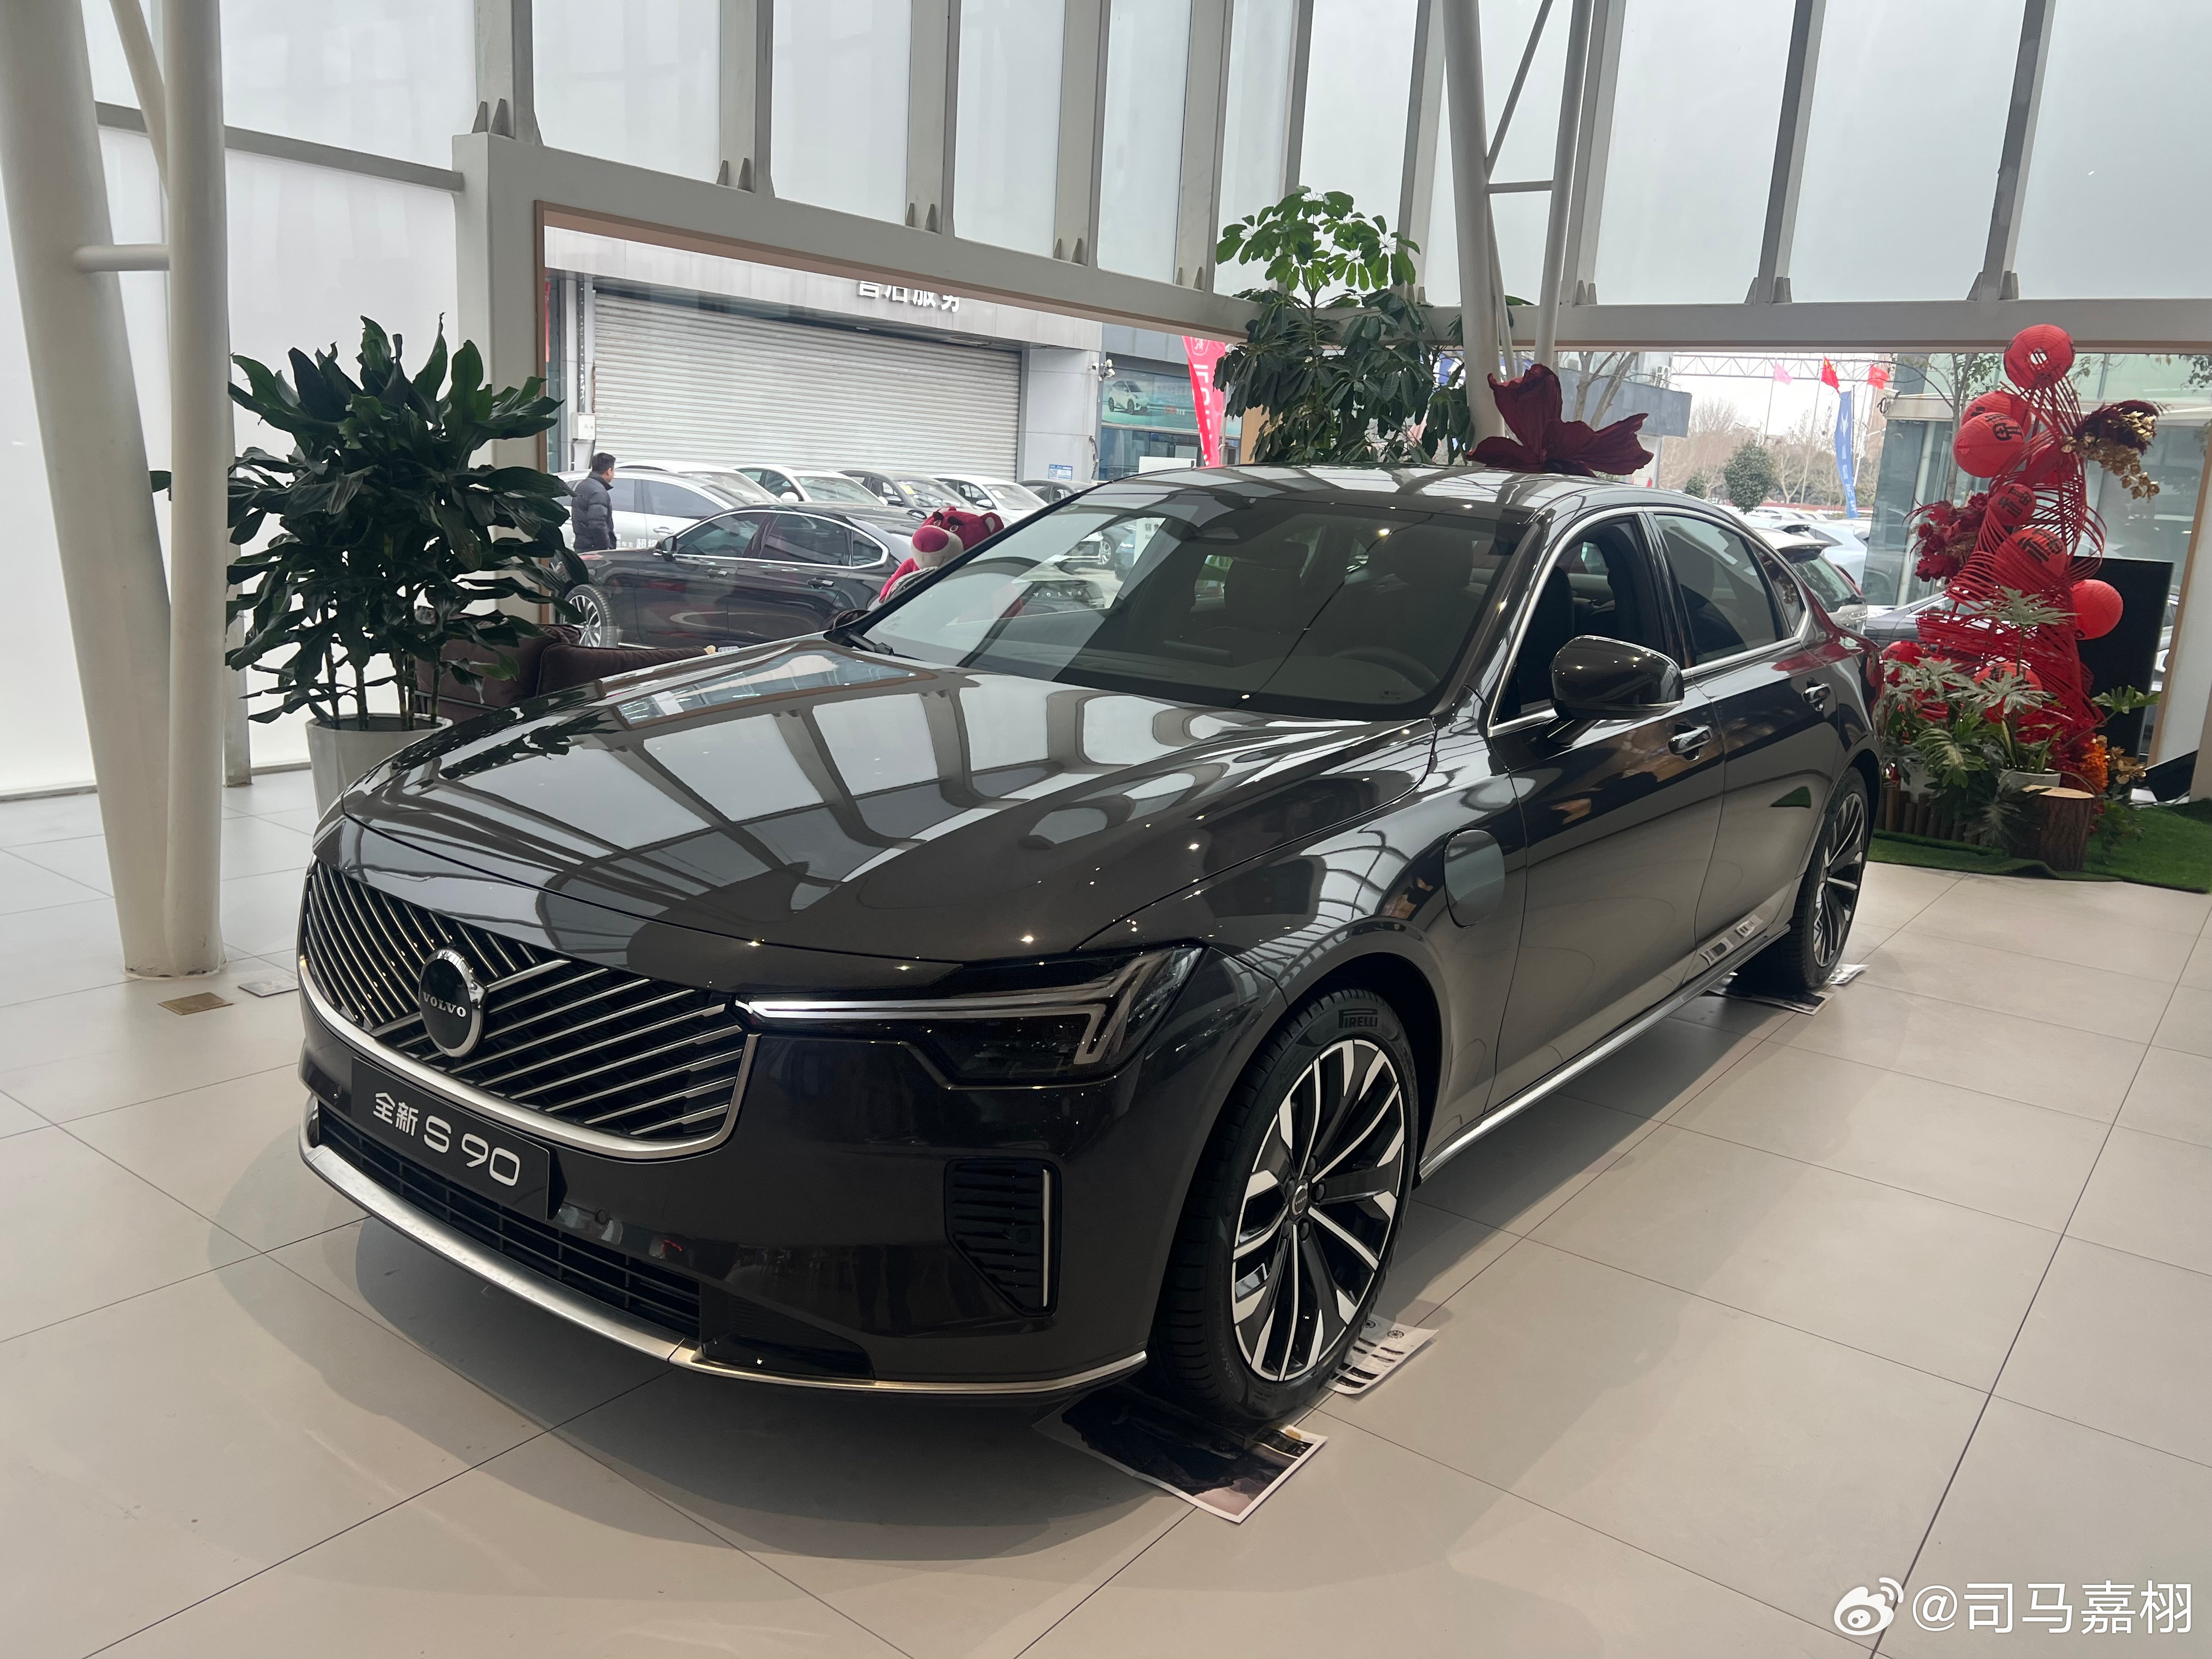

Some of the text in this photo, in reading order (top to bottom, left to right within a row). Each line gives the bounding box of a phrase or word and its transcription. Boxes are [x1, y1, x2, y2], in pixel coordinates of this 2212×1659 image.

[423, 991, 466, 1017] VOLVO
[1339, 1008, 1378, 1029] PIRELLI
[373, 1093, 419, 1136] 全新
